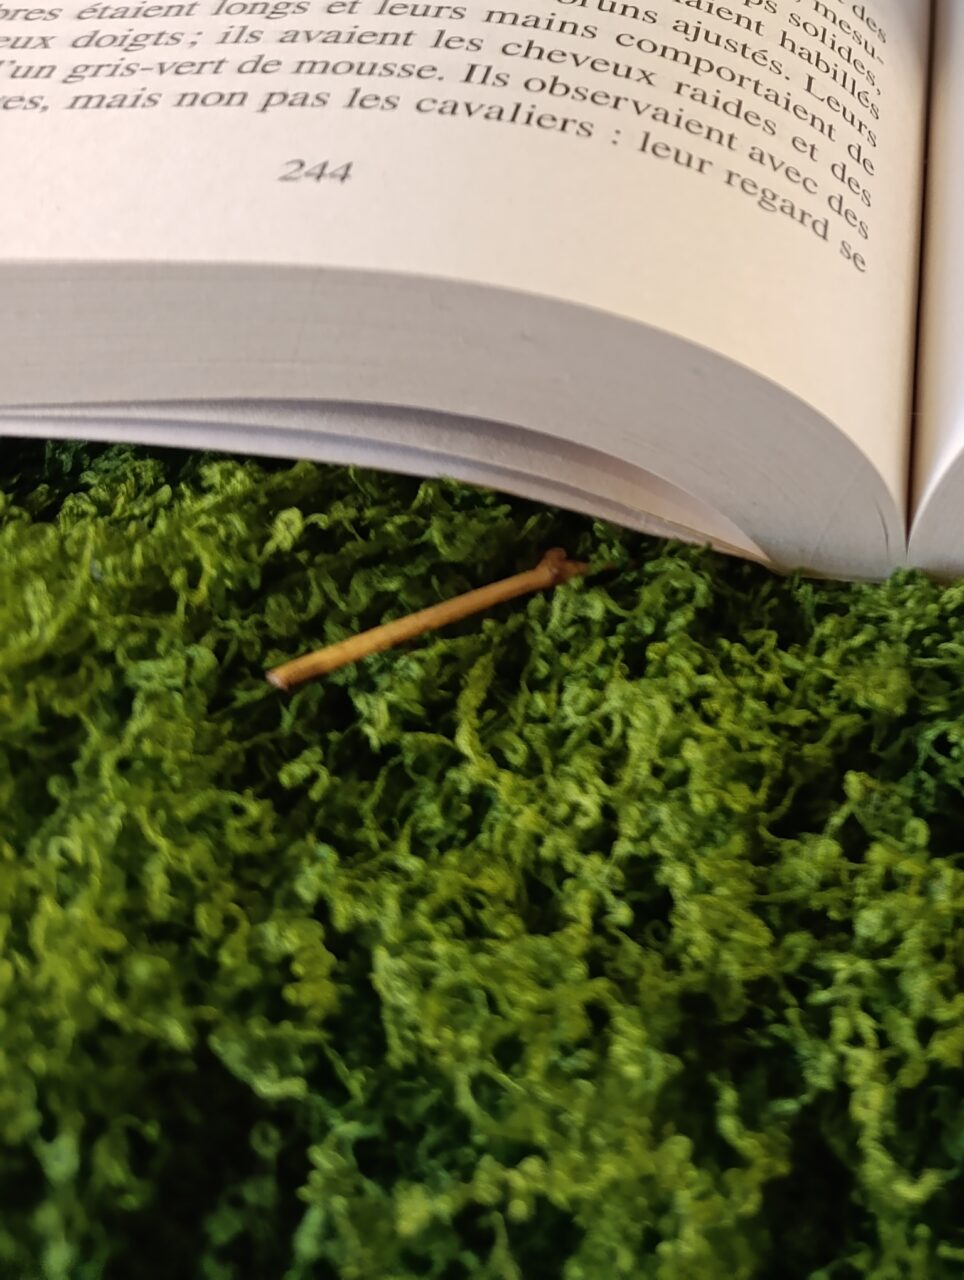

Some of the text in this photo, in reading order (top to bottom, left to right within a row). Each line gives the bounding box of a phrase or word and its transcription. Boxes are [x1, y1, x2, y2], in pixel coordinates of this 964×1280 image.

[779, 29, 880, 120] habillés
[787, 12, 882, 96] solides,
[812, 0, 885, 65] mesu-
[852, 4, 886, 43] des
[76, 1, 202, 20] étaient
[326, 0, 362, 15] et
[482, 9, 599, 40] mains
[615, 32, 836, 142] comportaient
[846, 142, 875, 177] de
[215, 25, 264, 45] ils
[278, 25, 417, 47] avaient
[428, 29, 484, 53] les
[500, 39, 657, 87] cheveux
[673, 79, 777, 137] raides
[791, 135, 819, 162] et
[830, 161, 872, 208] des
[672, 19, 791, 81] ajustés.
[803, 73, 877, 148] Leurs
[60, 54, 870, 240] gris-vert de mousse. Ils observaient avec des
[64, 87, 866, 273] mais non pas les cavaliers leur regard se
[277, 158, 354, 183] 244
